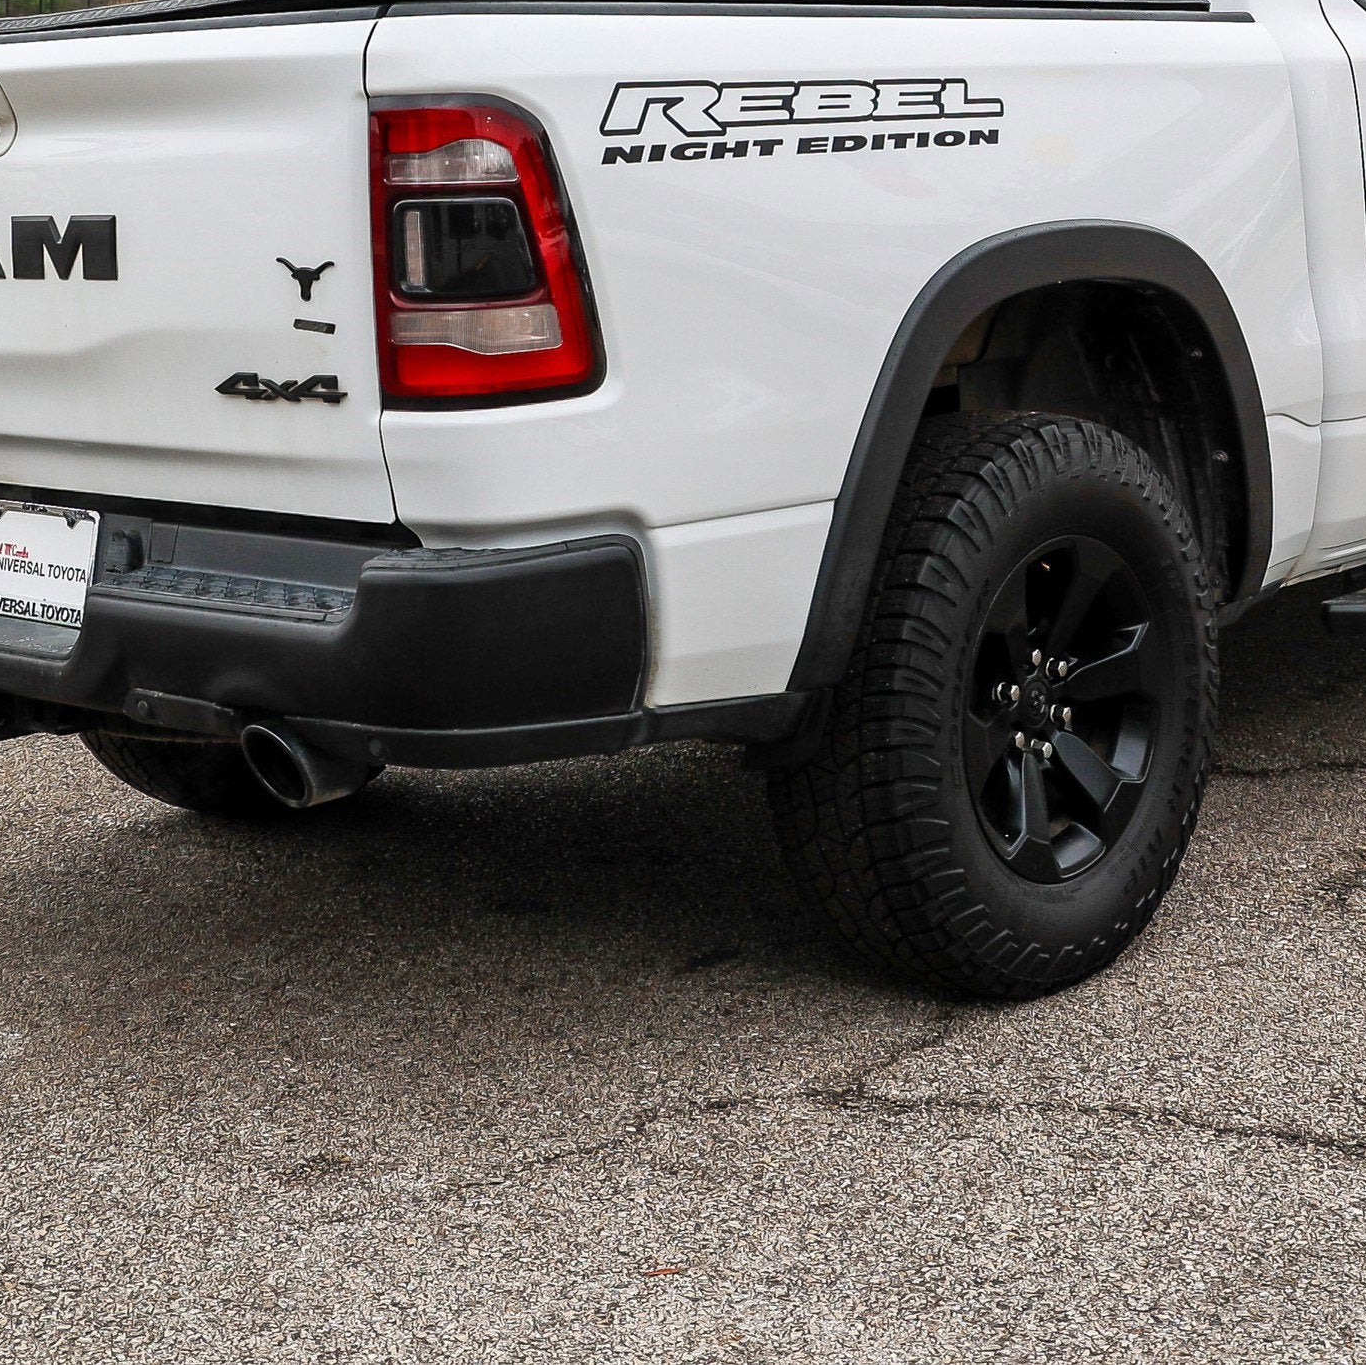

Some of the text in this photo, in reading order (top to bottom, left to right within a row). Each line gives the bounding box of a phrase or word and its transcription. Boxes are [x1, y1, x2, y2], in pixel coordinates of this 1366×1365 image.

[599, 78, 1004, 137] REBEL
[601, 129, 1000, 166] NIGHT EDITION
[48, 564, 87, 584] TOYOTA
[40, 604, 83, 626] TOYOTA
